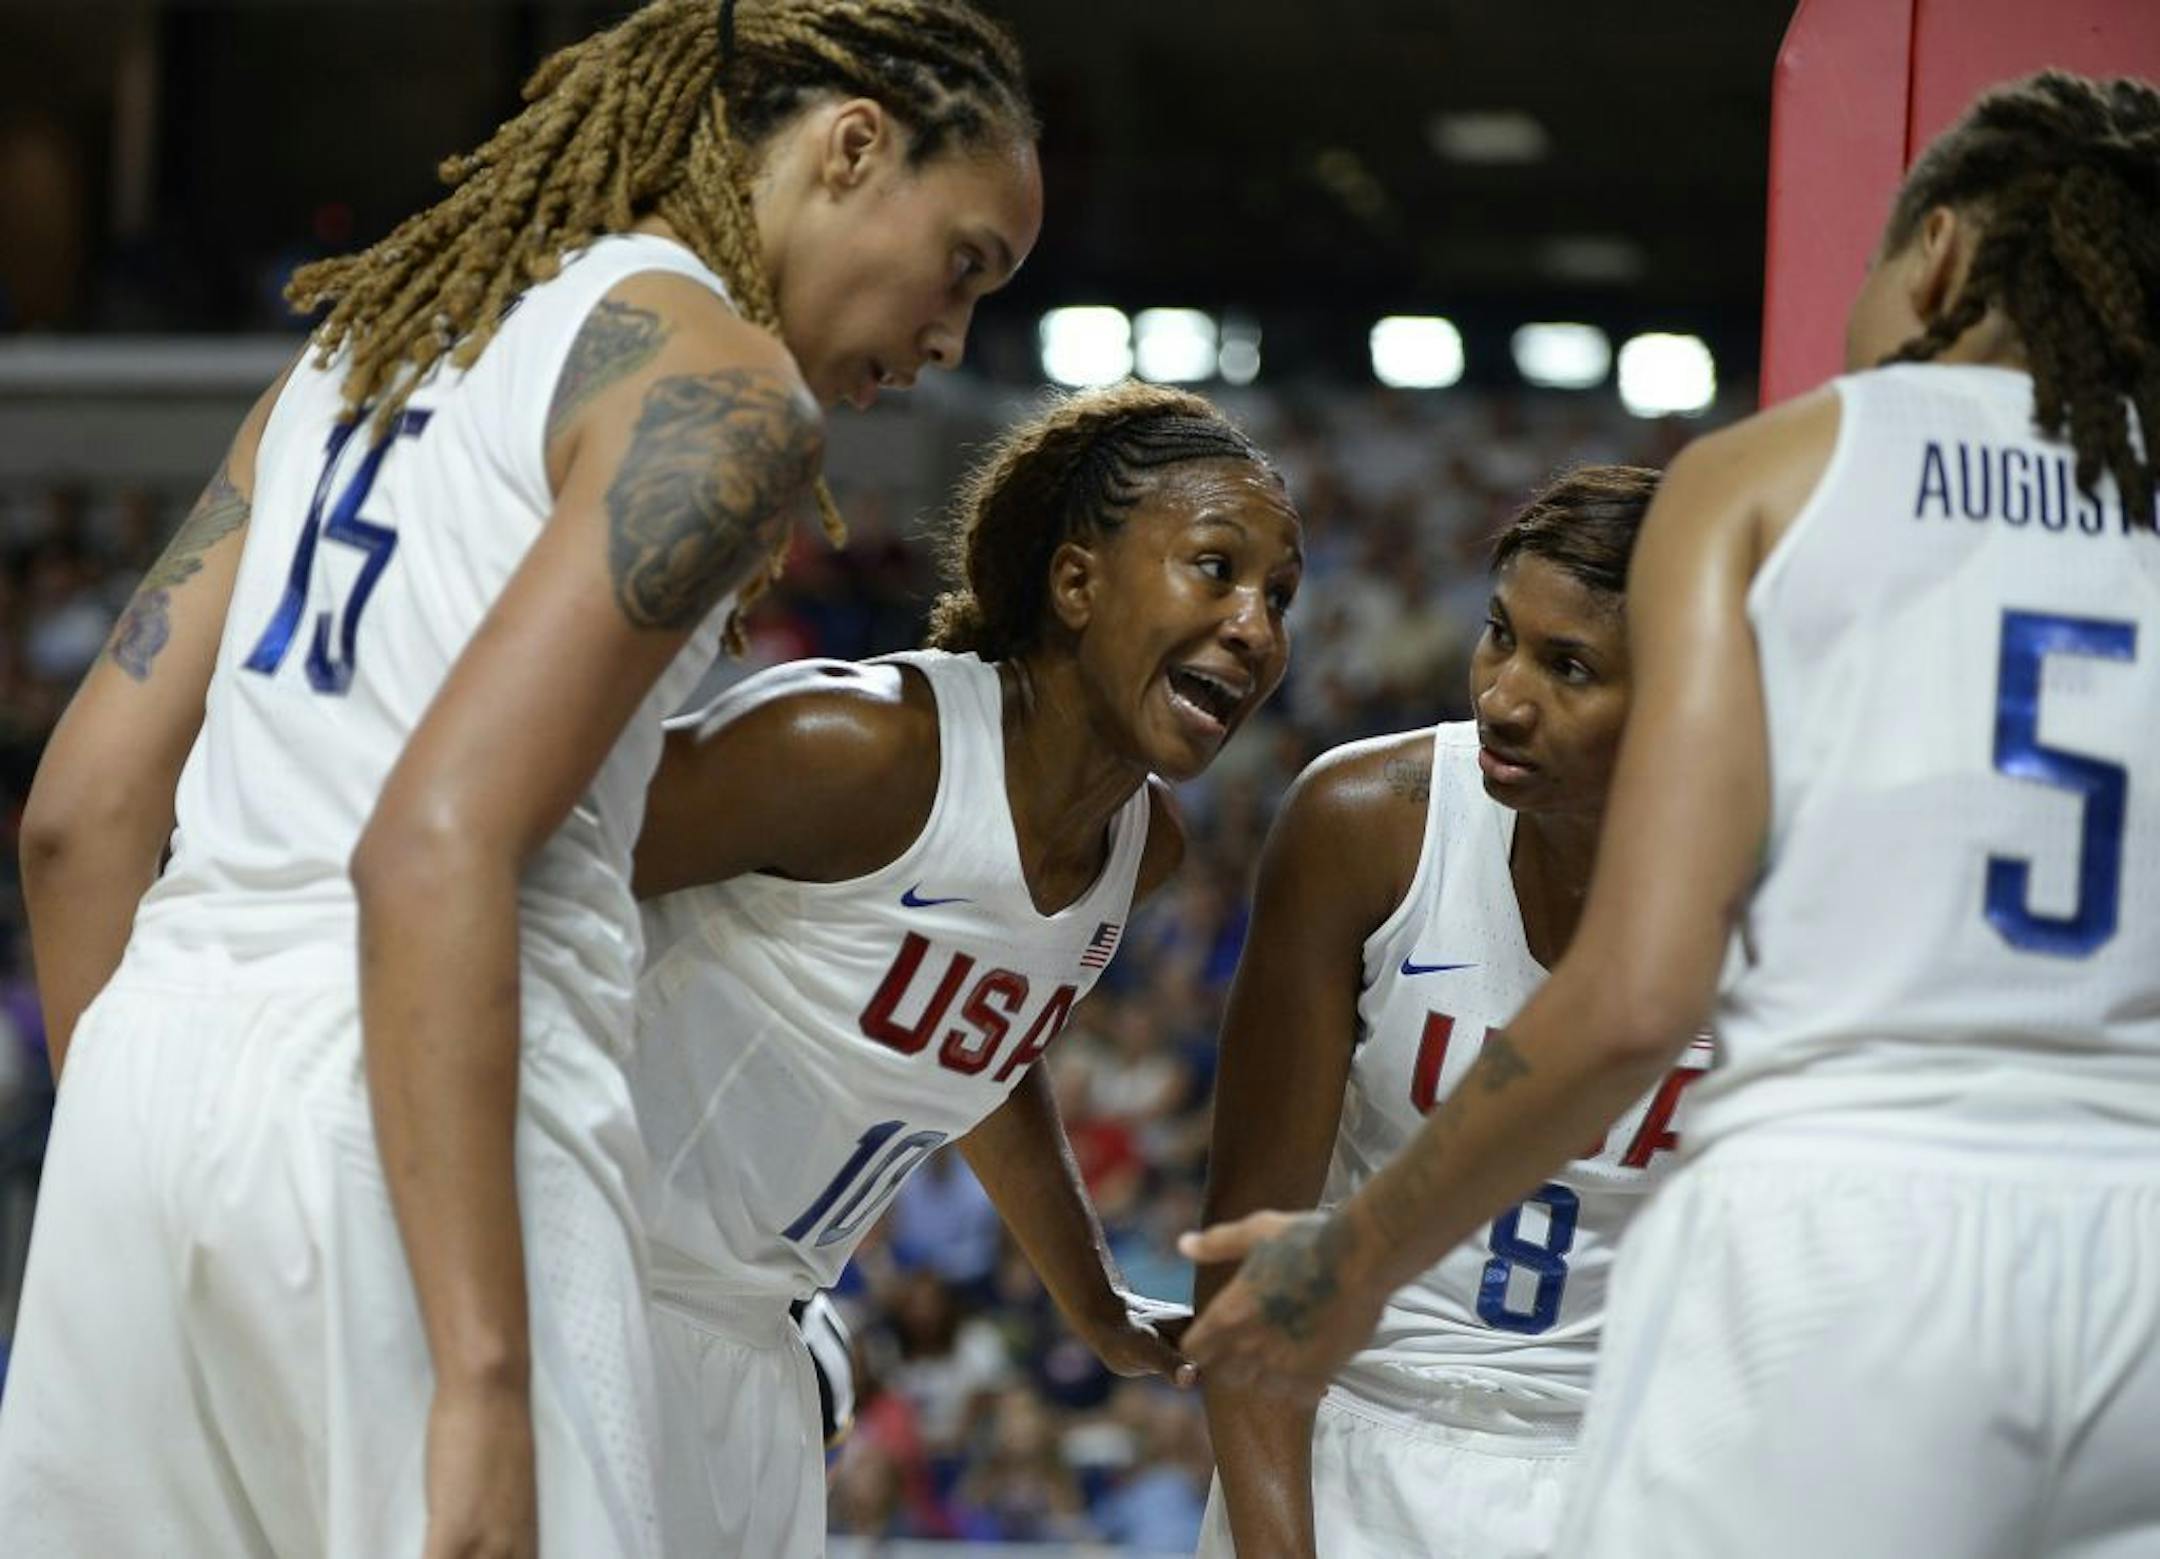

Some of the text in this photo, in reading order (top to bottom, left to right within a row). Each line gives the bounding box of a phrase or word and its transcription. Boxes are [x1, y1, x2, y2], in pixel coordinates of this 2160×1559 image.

[242, 407, 434, 695] 15
[1984, 608, 2137, 960] 5
[859, 930, 1078, 1082] USA
[1410, 1010, 1708, 1168] UA
[781, 1120, 948, 1247] 10
[1476, 1183, 1580, 1334] 8
